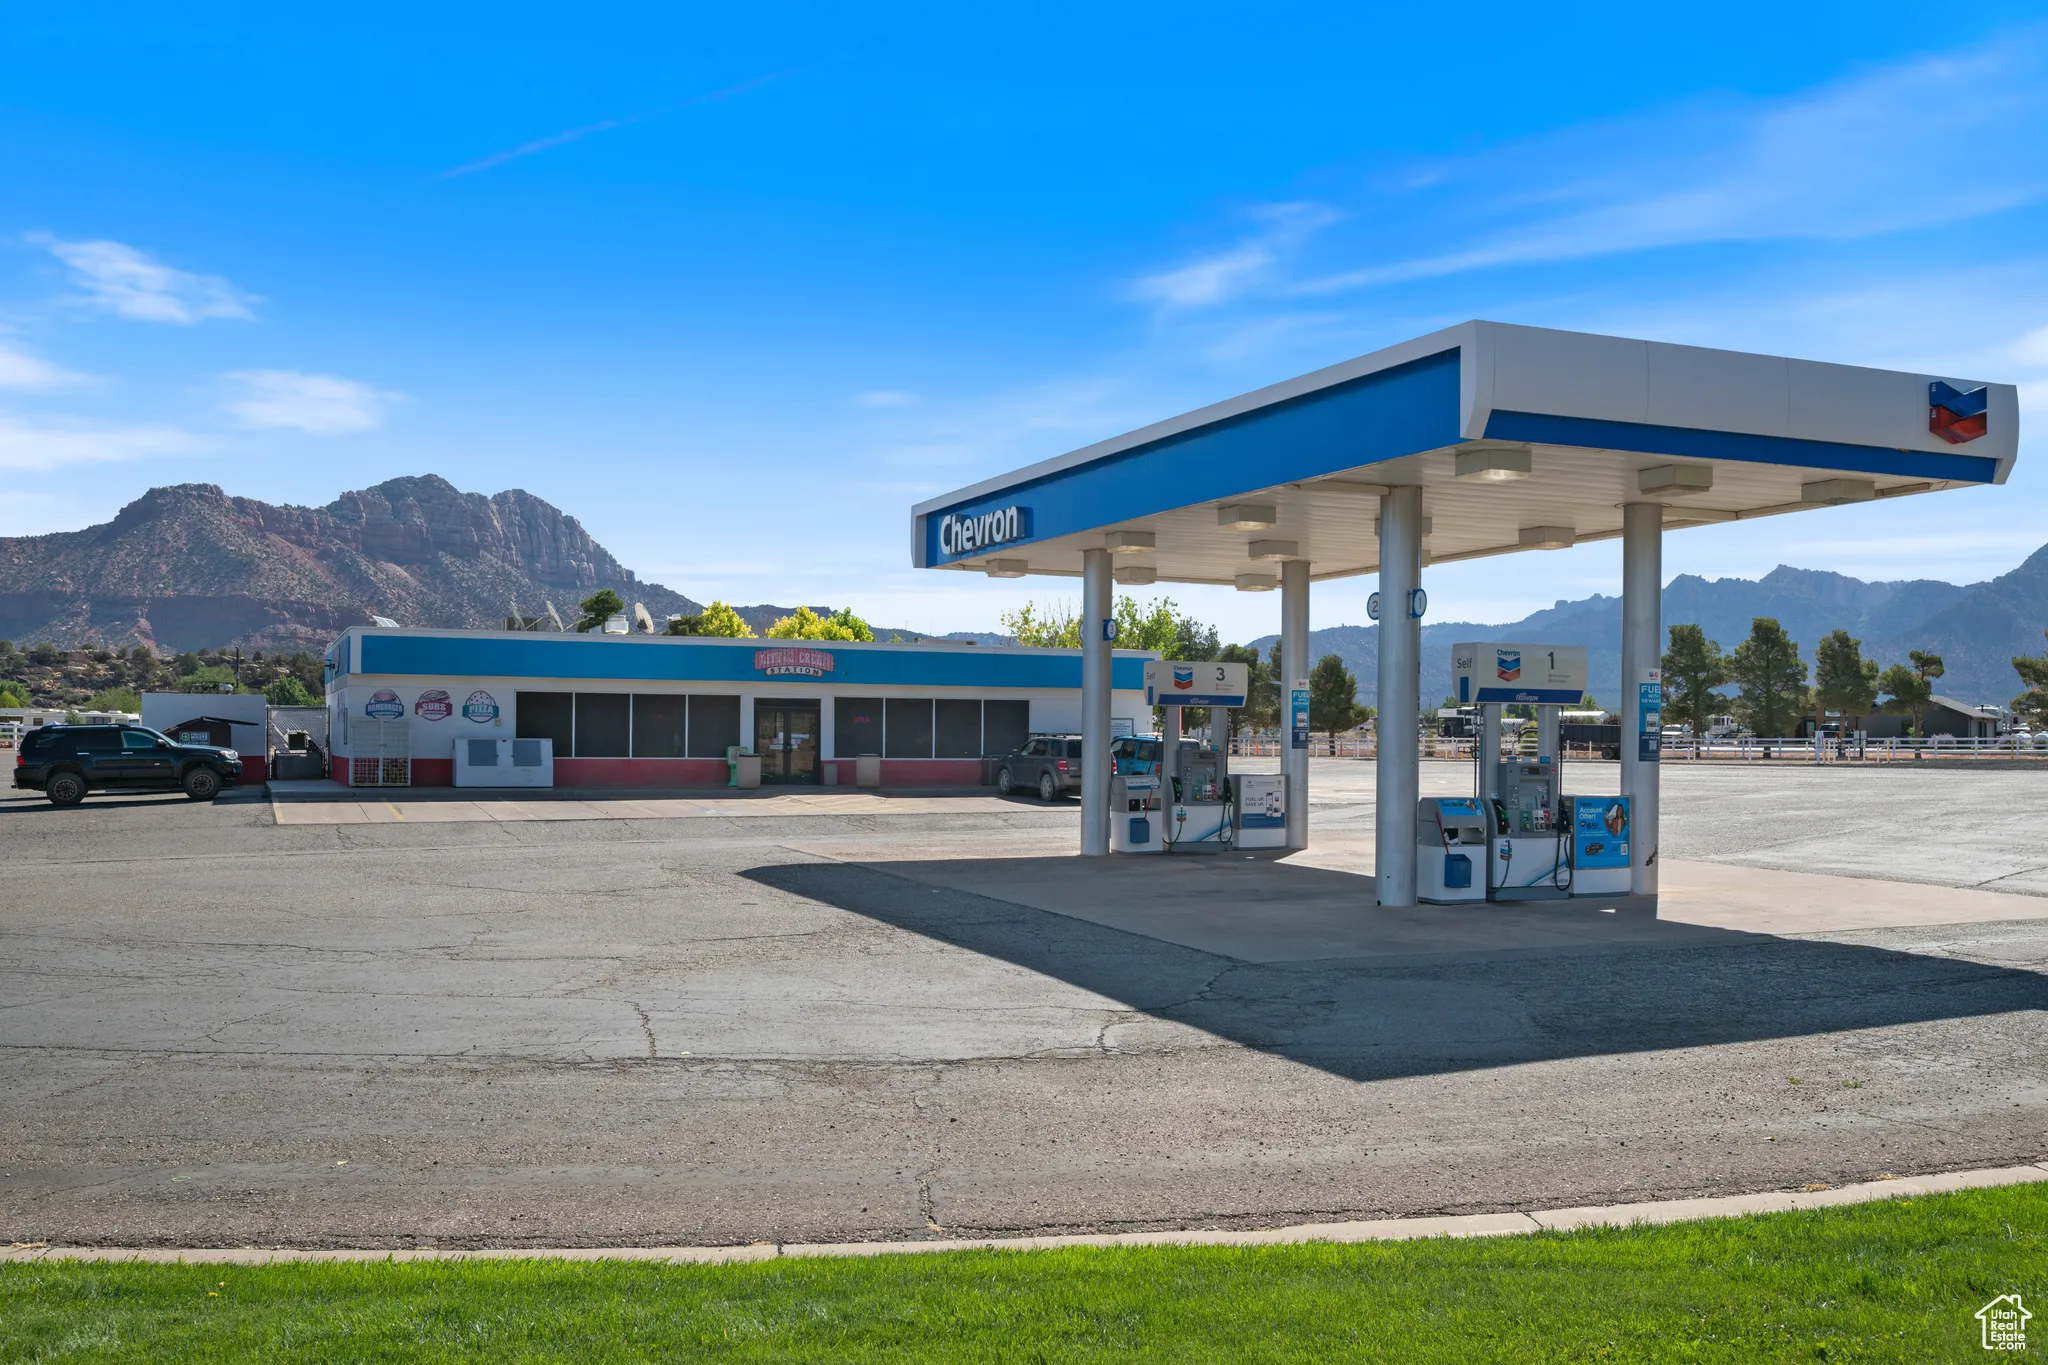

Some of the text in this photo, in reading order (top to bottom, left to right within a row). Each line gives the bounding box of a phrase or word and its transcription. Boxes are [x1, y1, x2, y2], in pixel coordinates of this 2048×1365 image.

[940, 506, 1018, 555] Chevron
[1372, 600, 1379, 613] 2
[1109, 623, 1114, 635] 3
[1497, 649, 1521, 657] Chevron
[1456, 657, 1473, 669] Self
[1547, 651, 1555, 670] 1
[769, 666, 820, 676] STATION
[1146, 671, 1156, 681] Self
[1215, 667, 1226, 681] 3
[367, 703, 403, 713] HAMBURGER
[422, 702, 446, 711] SUBS
[469, 704, 494, 714] PIZZA
